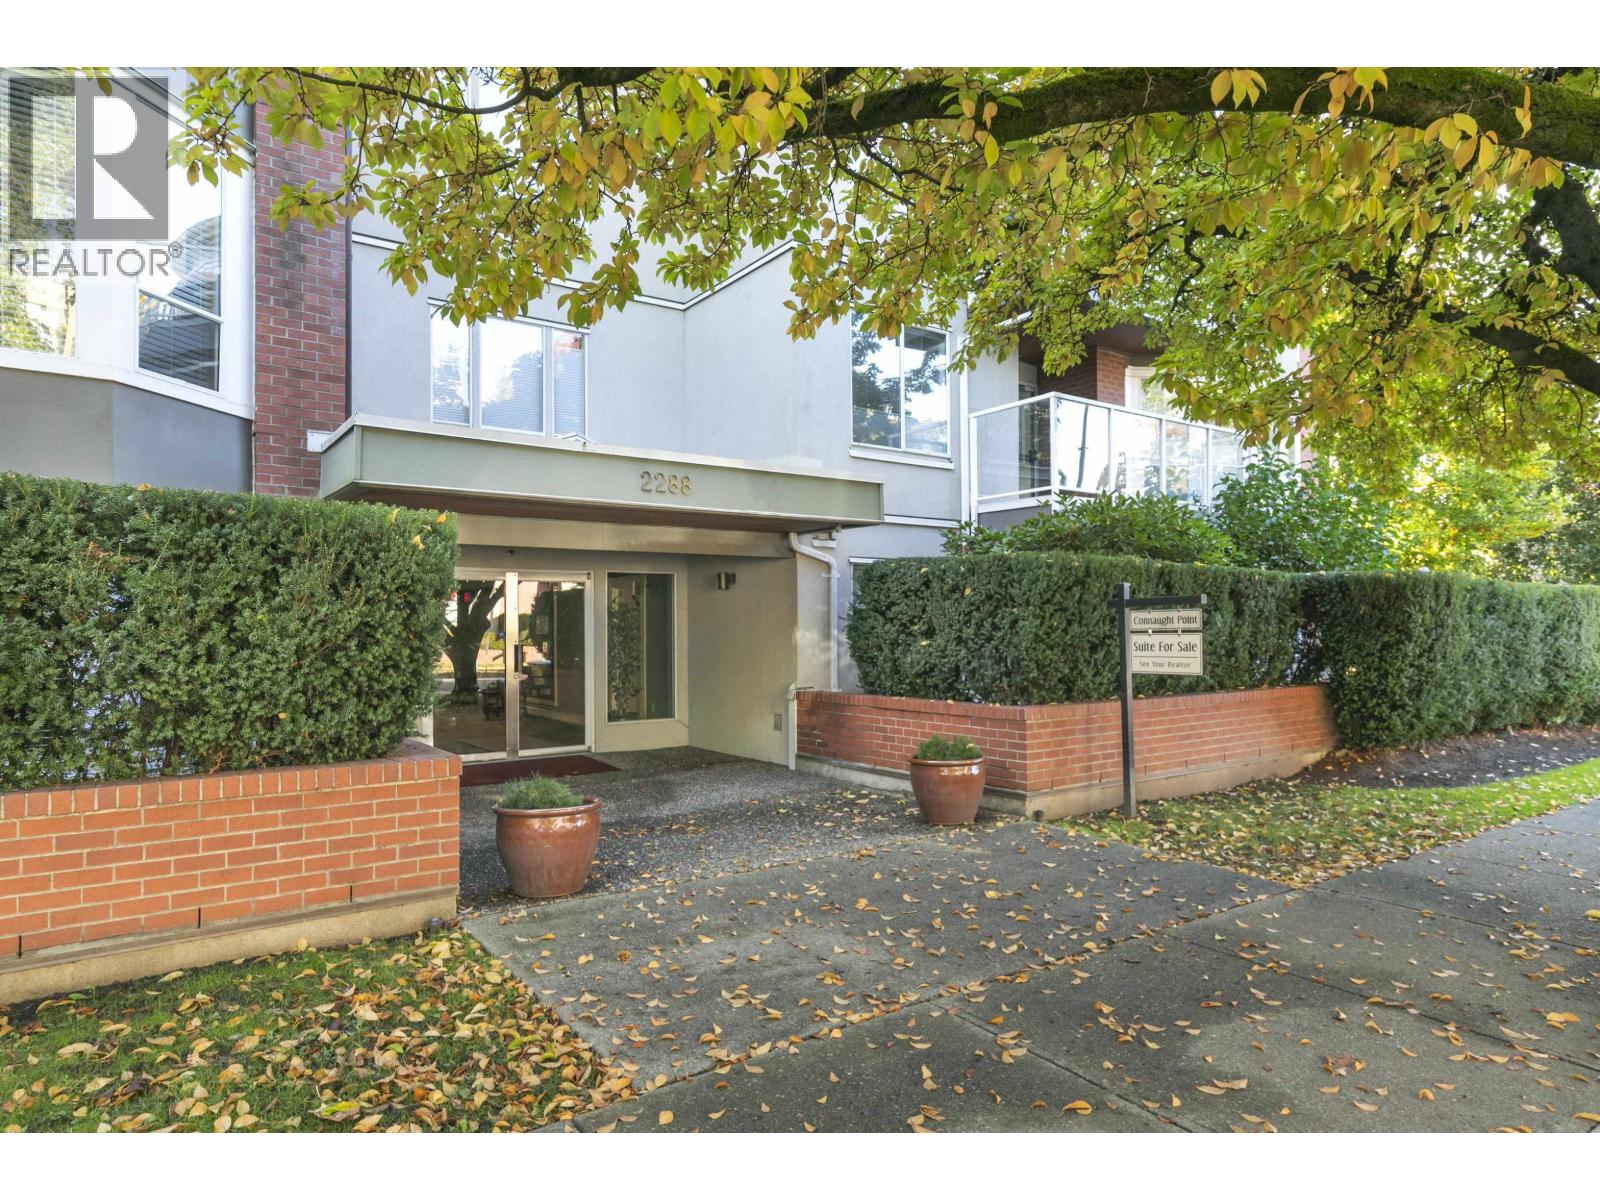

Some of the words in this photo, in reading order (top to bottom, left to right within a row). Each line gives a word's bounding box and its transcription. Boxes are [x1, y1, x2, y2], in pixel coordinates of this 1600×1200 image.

[640, 470, 692, 496] 2288
[1133, 615, 1174, 626] Connaught
[1177, 614, 1198, 625] Point
[1133, 641, 1156, 652] Suite
[1158, 641, 1174, 652] For
[1177, 641, 1198, 653] Sale
